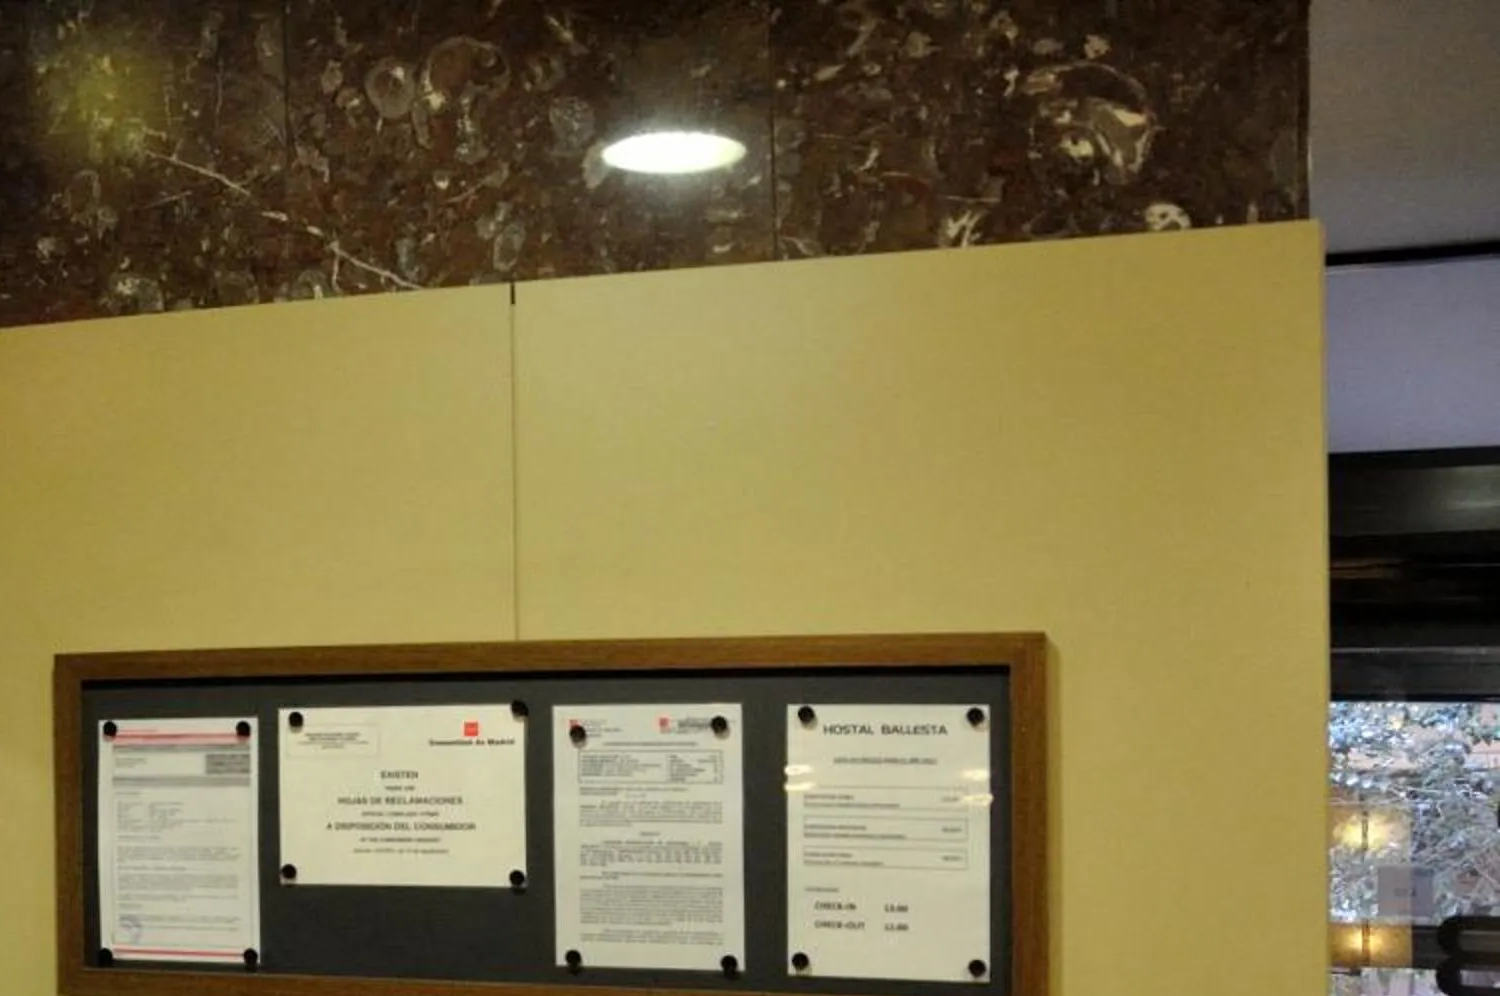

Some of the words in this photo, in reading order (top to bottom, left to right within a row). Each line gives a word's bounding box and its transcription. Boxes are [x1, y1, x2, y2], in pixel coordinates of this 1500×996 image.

[823, 724, 874, 736] HOSTAL
[881, 724, 948, 736] BALLESTA
[370, 796, 383, 805] DE
[385, 796, 463, 805] RECLAMACIONES
